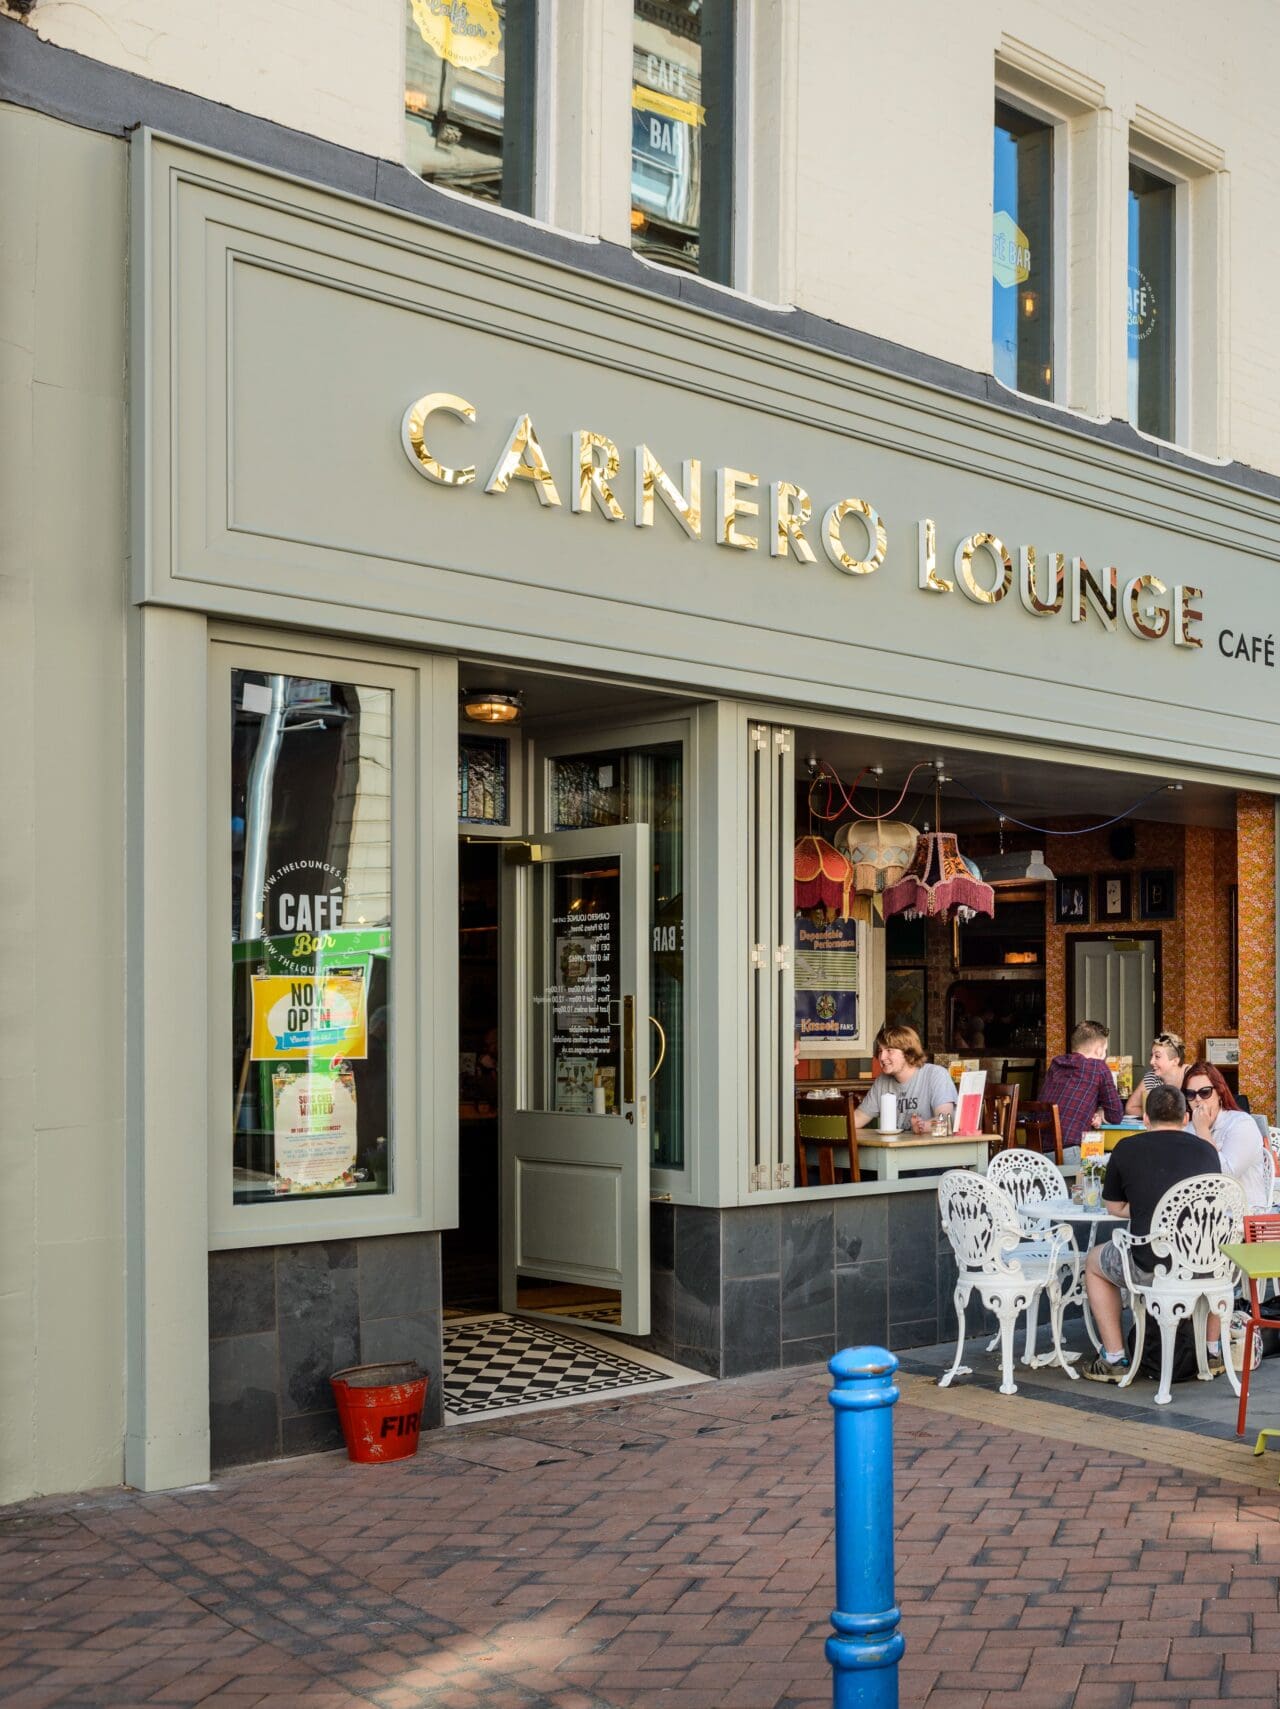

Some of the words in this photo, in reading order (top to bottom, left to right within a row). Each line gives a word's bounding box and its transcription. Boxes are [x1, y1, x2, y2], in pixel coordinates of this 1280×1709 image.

[452, 19, 488, 38] Bar
[1008, 241, 1031, 272] BAR
[1128, 287, 1147, 318] AFÉ
[401, 392, 888, 576] CARNERO
[917, 518, 1204, 649] LOUNGE
[1218, 628, 1275, 668] CAFÉ
[279, 886, 343, 932] CAFÉ
[292, 932, 336, 957] Bar
[800, 929, 843, 941] Dependable
[814, 939, 855, 950] Performance
[840, 1023, 854, 1031] FANS
[381, 1411, 421, 1438] FIR
